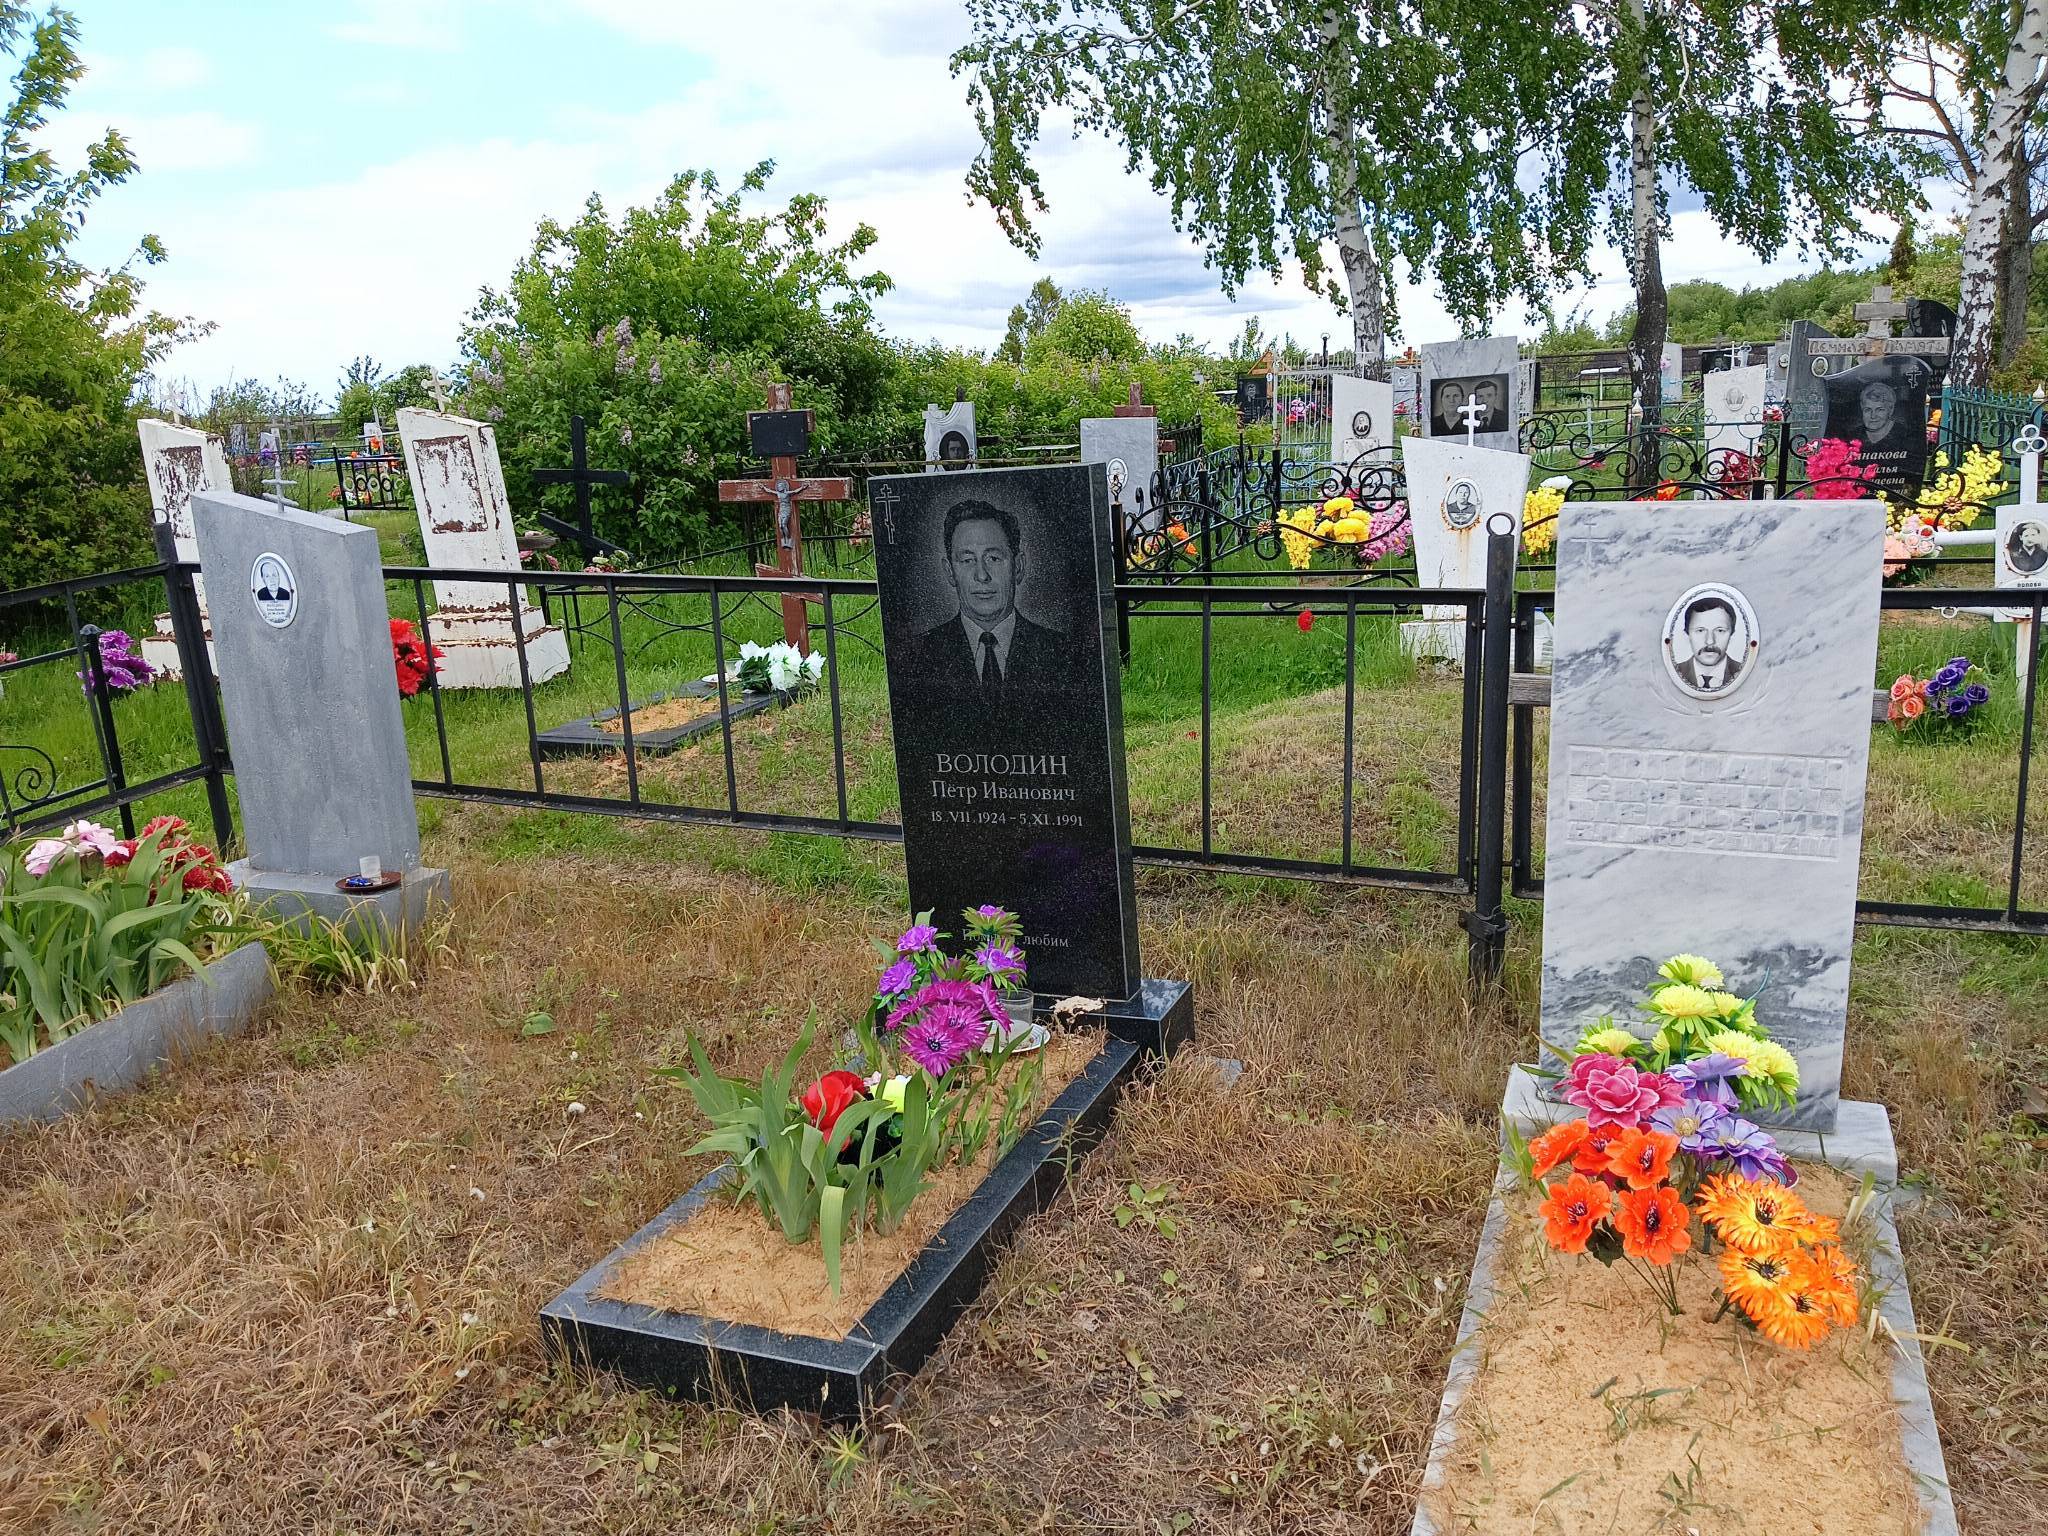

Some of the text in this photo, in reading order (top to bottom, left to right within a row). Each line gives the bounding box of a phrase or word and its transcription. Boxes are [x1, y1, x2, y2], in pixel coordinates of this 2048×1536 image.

[936, 753, 1068, 775] ВОЛОДИН
[931, 780, 1076, 804] Пётр Иванович
[1022, 933, 1069, 948] любим
